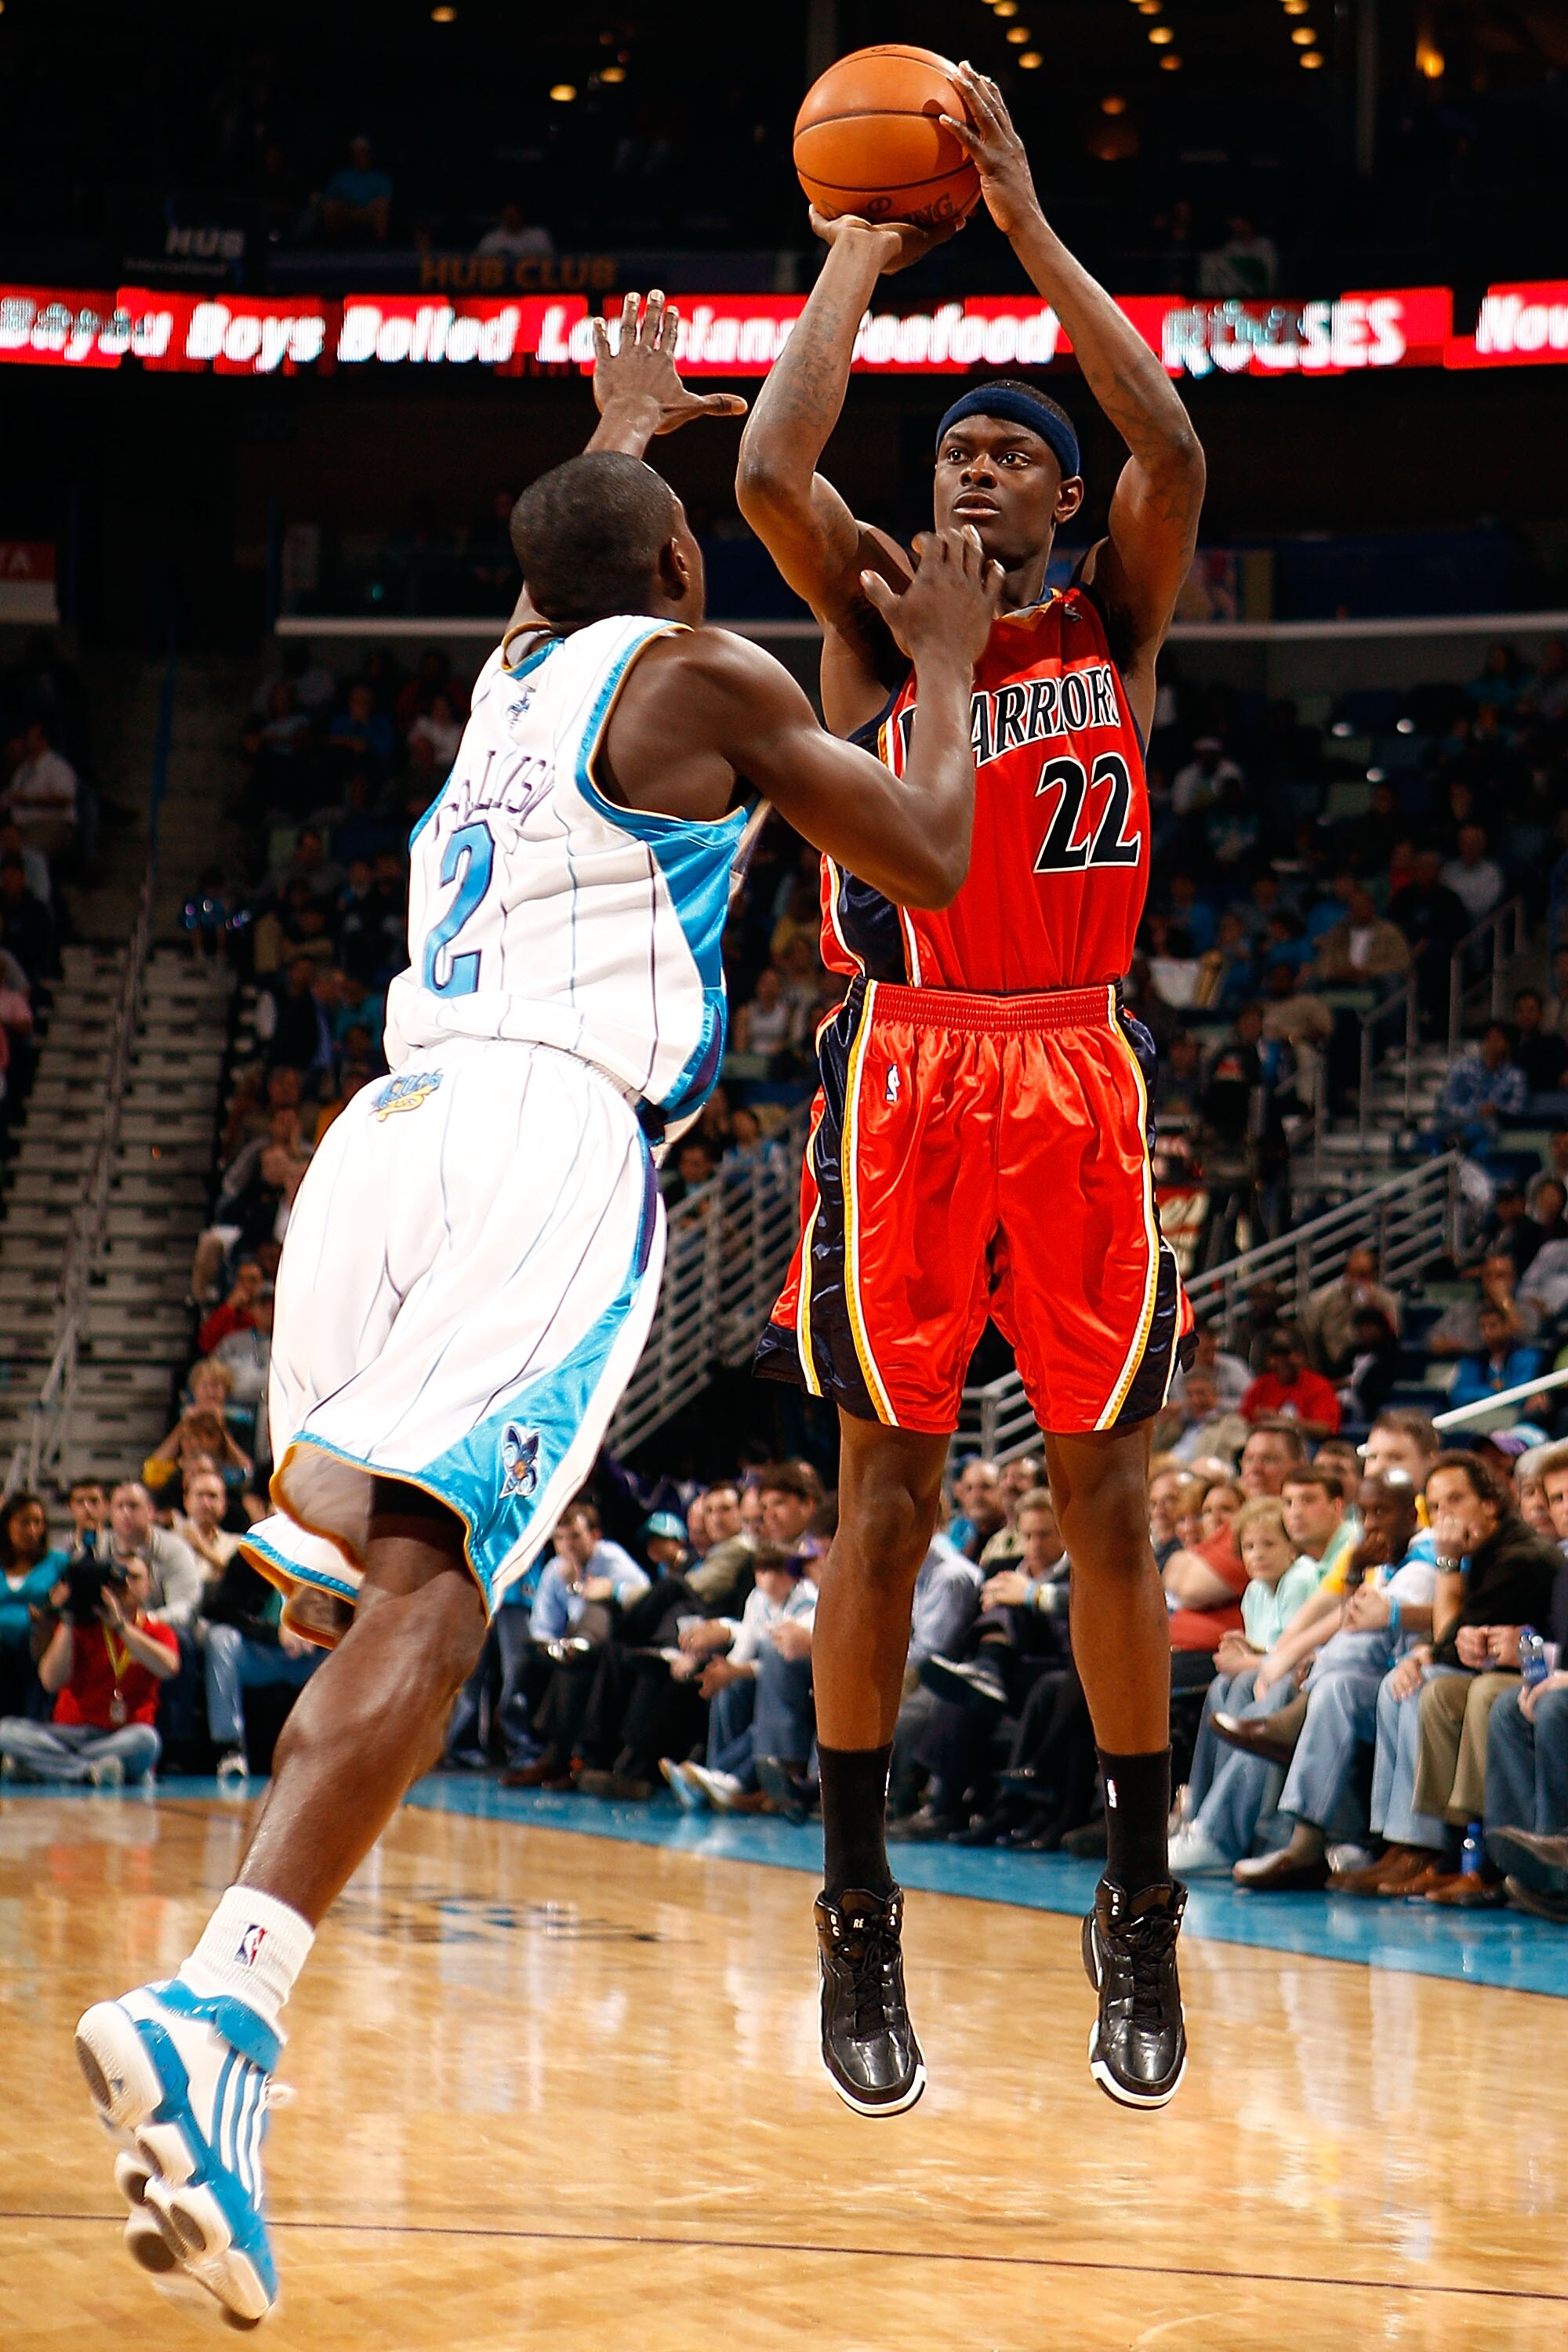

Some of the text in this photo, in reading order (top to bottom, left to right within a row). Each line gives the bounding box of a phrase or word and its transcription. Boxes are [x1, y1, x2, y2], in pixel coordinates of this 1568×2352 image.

[165, 226, 245, 260] HUB
[419, 255, 619, 290] HUB CLUB
[185, 301, 326, 374] Boys
[851, 302, 1060, 365] eafood
[1161, 299, 1407, 379] ROUSES
[1033, 751, 1142, 874] 22
[423, 818, 495, 1000] 2
